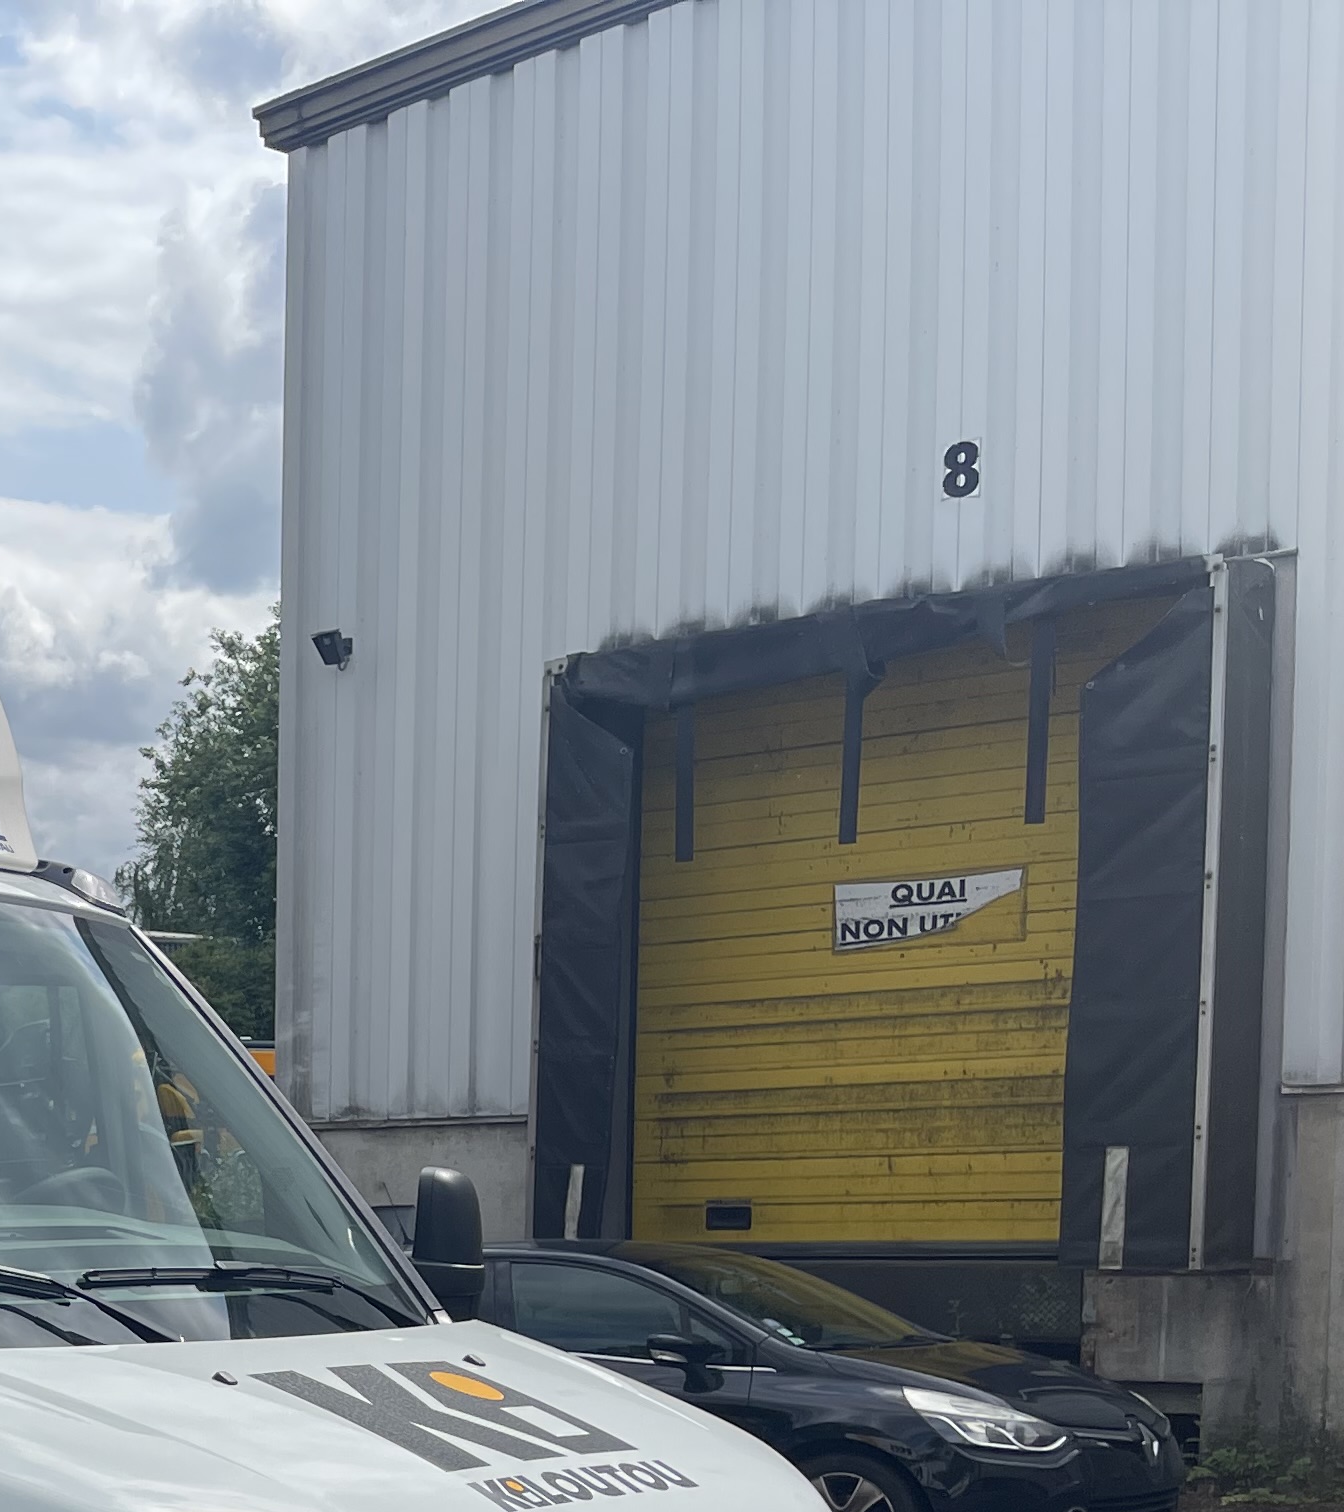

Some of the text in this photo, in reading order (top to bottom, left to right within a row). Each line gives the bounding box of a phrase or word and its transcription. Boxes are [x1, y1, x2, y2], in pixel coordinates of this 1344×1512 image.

[942, 441, 980, 498] 8
[891, 878, 966, 904] QUAI
[840, 917, 909, 942] NON
